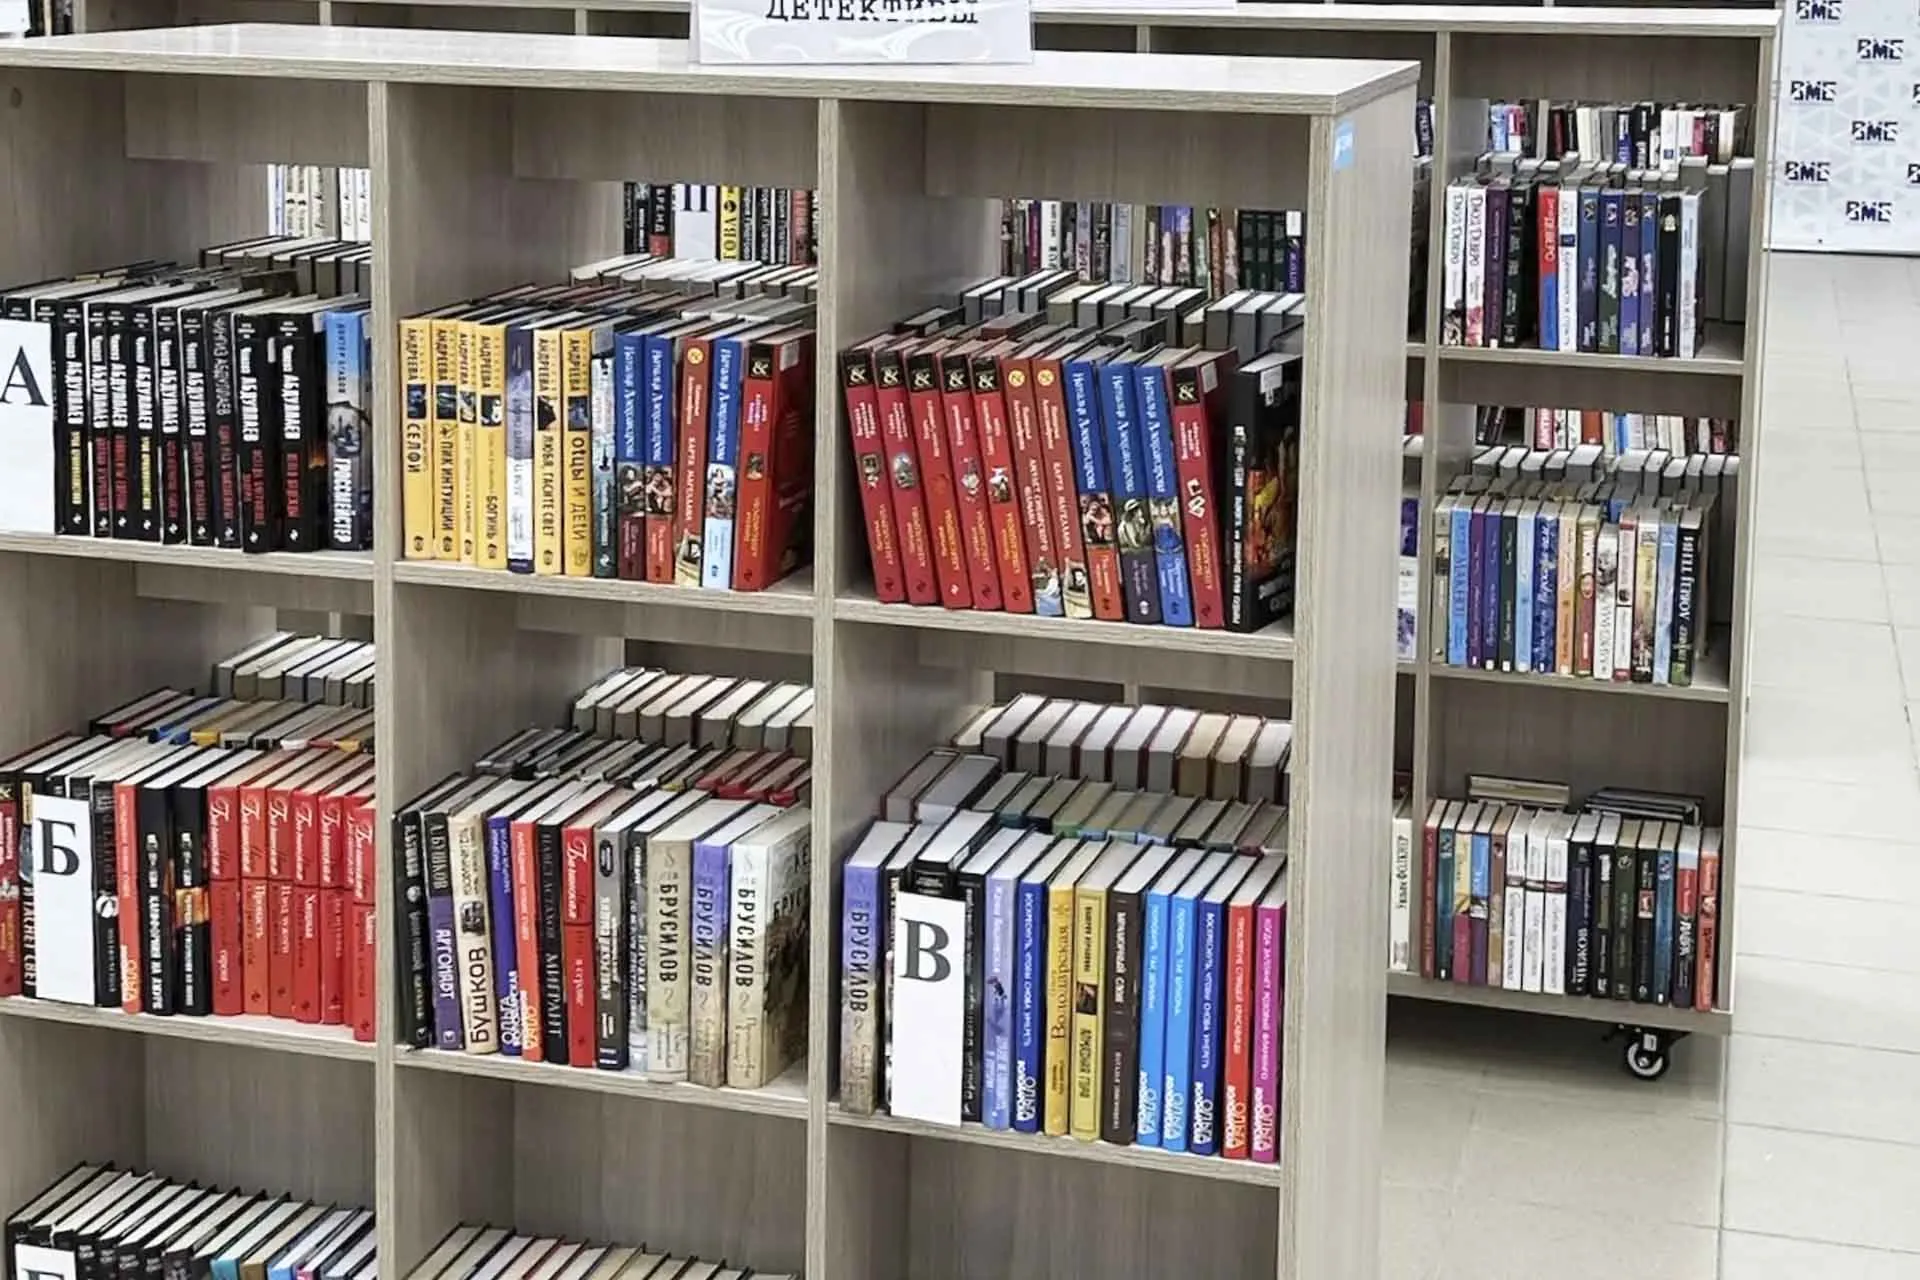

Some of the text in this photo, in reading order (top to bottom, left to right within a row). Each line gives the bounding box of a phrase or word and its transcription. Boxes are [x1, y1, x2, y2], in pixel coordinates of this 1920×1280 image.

[0, 345, 49, 407] А
[407, 328, 419, 381] АНДРЕЕВА
[438, 329, 449, 381] АНДРЕЕВА
[459, 333, 470, 385] АНДРЕЕВА
[480, 336, 491, 388] АНДРЕЕВА
[538, 338, 550, 391] АНДРЕЕВА
[569, 338, 580, 391] АНДРЕЕВА
[407, 423, 420, 472] СЕЛФИ
[333, 457, 355, 543] ГРОССМЕЙСТЕР
[440, 441, 454, 530] ПИК ИНТУИЦИИ
[542, 472, 554, 507] ГАСИТЕ
[486, 495, 498, 539] БОГИНЬ
[542, 508, 554, 537] СВЕТ
[37, 817, 80, 877] Б
[658, 884, 679, 983] БРУСИЛОВ
[695, 888, 714, 986] БРУСИЛОВ
[735, 888, 756, 987] БРУСИЛОВ
[849, 912, 870, 1013] БРУСИЛОВ
[899, 919, 951, 982] В
[436, 929, 456, 1000] АРГОНАВТ
[469, 947, 491, 1045] БУШКОВ
[546, 953, 562, 1038] МИГРАНТ
